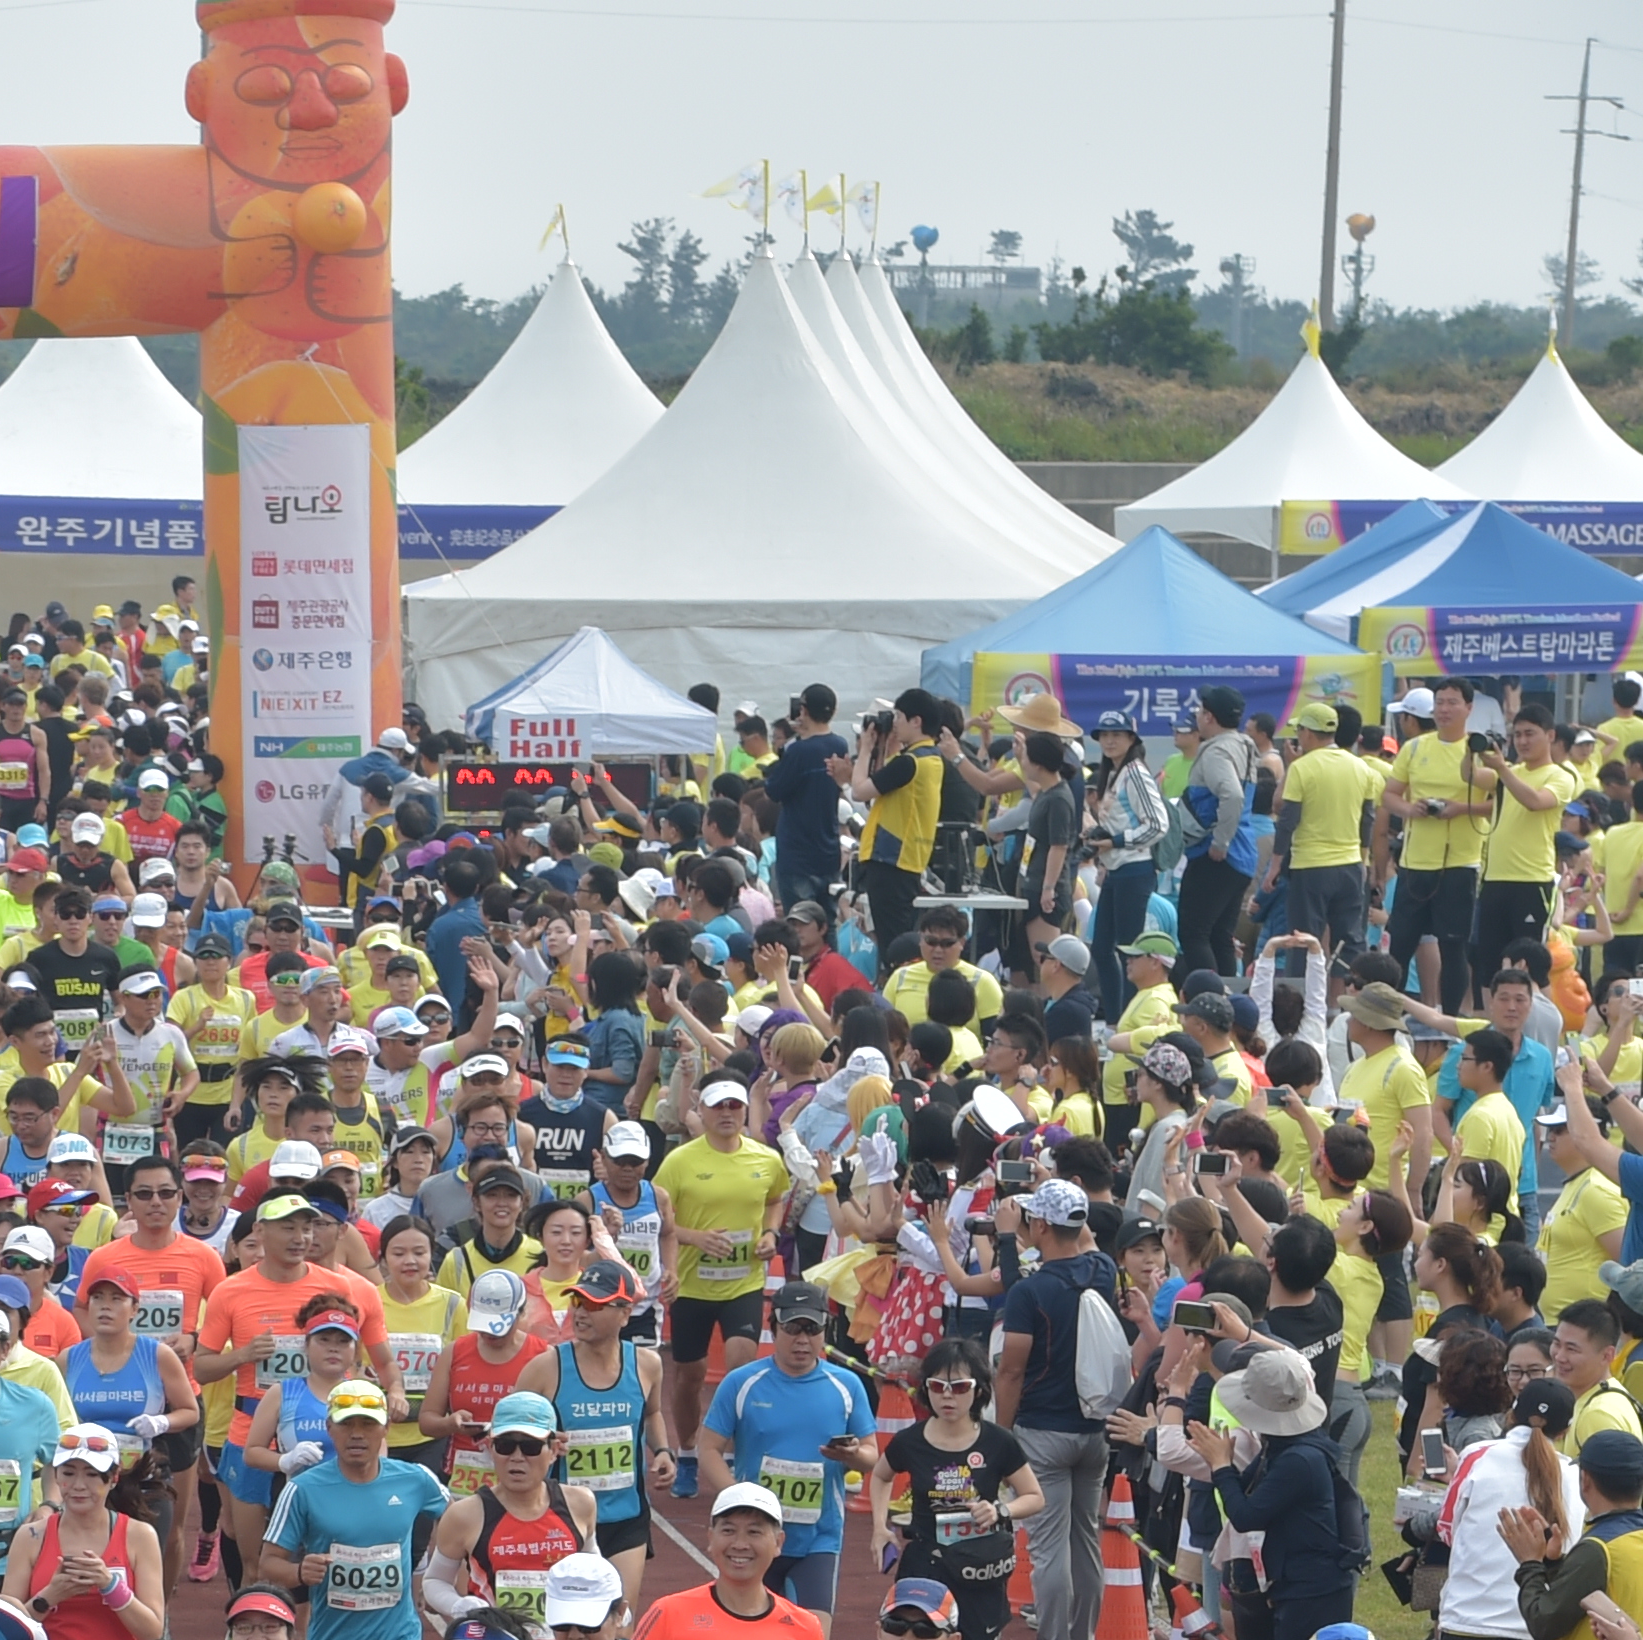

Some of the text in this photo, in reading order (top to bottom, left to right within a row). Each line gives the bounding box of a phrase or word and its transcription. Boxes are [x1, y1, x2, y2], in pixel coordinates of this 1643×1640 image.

[283, 558, 354, 575] 롯데면세점
[254, 606, 276, 615] DUTY
[254, 615, 276, 624] FREE
[1443, 631, 1615, 663] 제주베스트탑마라톤
[278, 651, 353, 670] 제주은행
[322, 690, 342, 703] EZ
[510, 719, 576, 737] Full
[259, 742, 284, 752] NH
[510, 739, 582, 758] Half
[106, 1133, 151, 1151] 1073
[537, 1128, 582, 1150] RUN
[571, 1445, 633, 1474] 2112
[963, 1555, 1017, 1580] adidas
[332, 1565, 399, 1592] 6029
